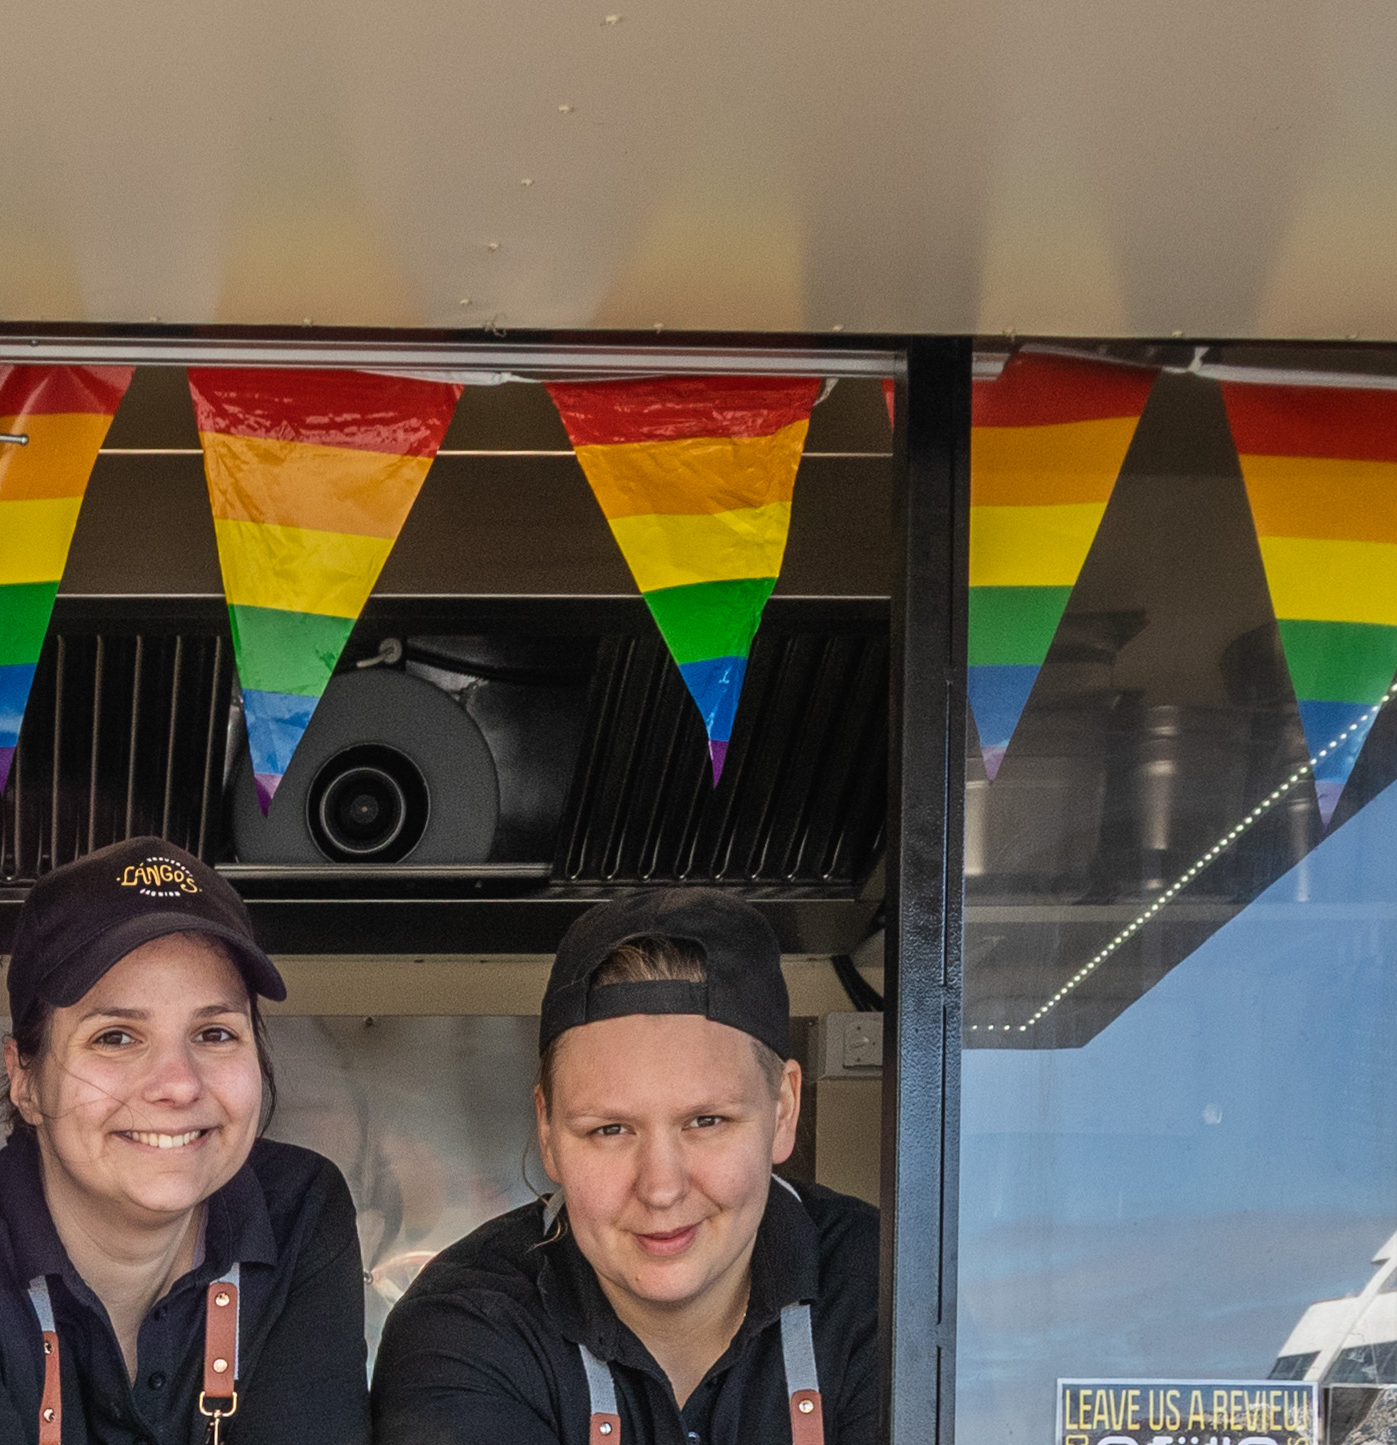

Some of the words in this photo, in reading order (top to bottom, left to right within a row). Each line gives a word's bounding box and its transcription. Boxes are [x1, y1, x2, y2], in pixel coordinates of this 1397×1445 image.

[1065, 1389, 1141, 1431] LEAVE
[1149, 1389, 1181, 1431] US
[1188, 1390, 1205, 1431] A
[1213, 1390, 1309, 1431] REVIEW
